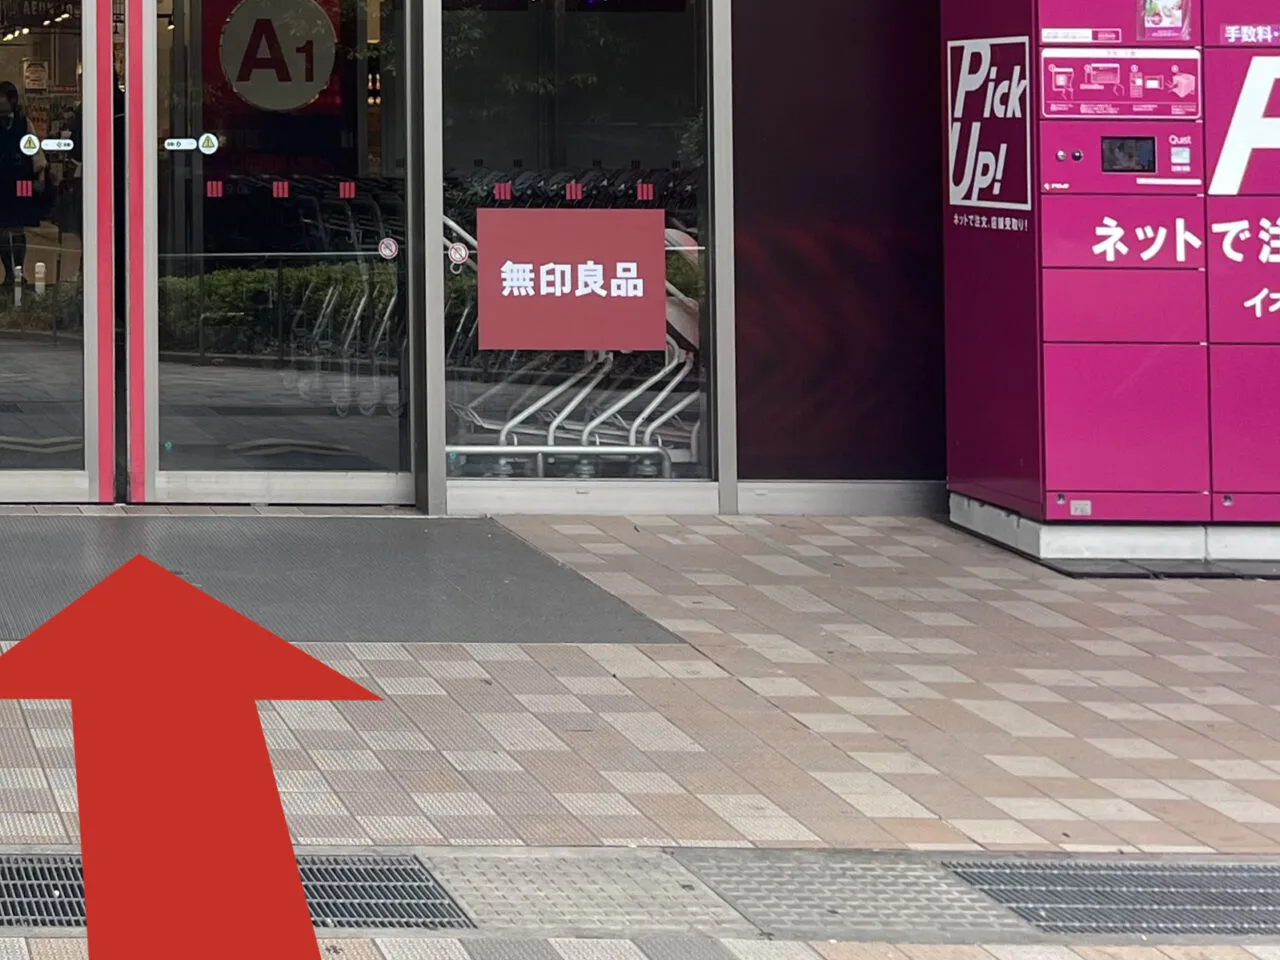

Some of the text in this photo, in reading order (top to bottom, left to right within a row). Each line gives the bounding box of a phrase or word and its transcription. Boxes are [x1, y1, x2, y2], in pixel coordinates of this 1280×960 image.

[235, 18, 315, 82] A1
[953, 42, 1027, 118] Pick
[950, 121, 1007, 201] Up!
[500, 260, 644, 297] 無印良品
